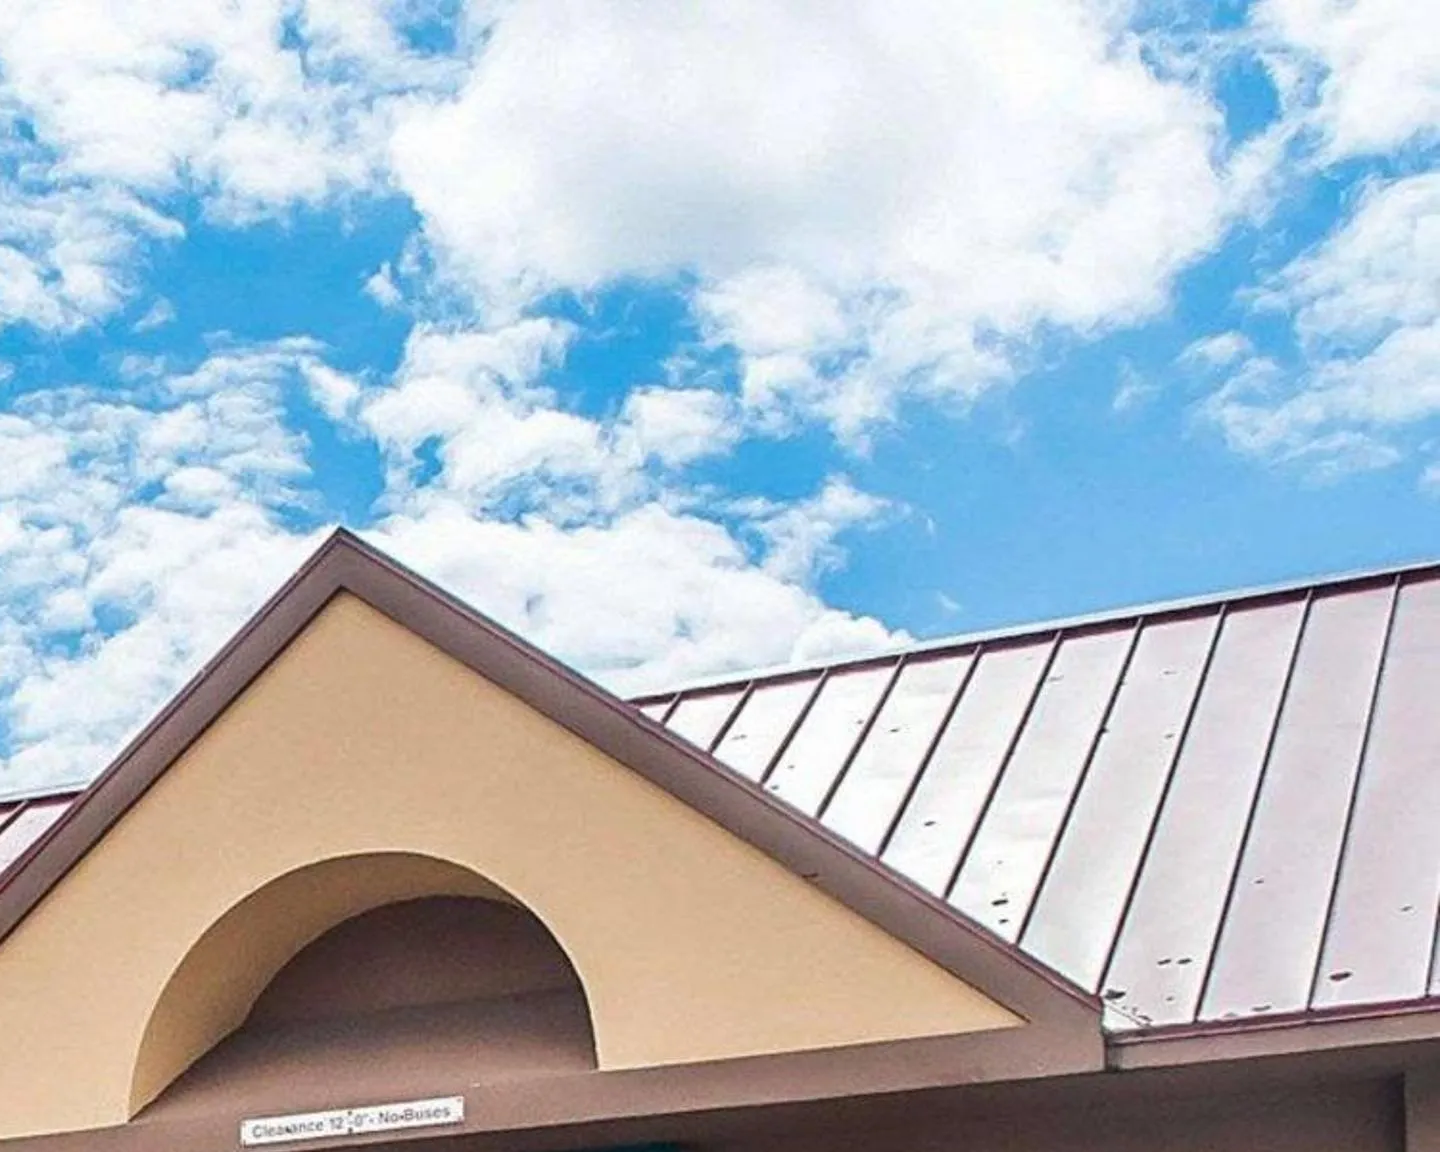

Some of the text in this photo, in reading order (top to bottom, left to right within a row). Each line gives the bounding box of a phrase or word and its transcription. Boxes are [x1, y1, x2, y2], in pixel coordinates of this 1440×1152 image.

[251, 1120, 324, 1138] Clearance
[379, 1111, 399, 1125] No
[403, 1106, 451, 1122] Buses
